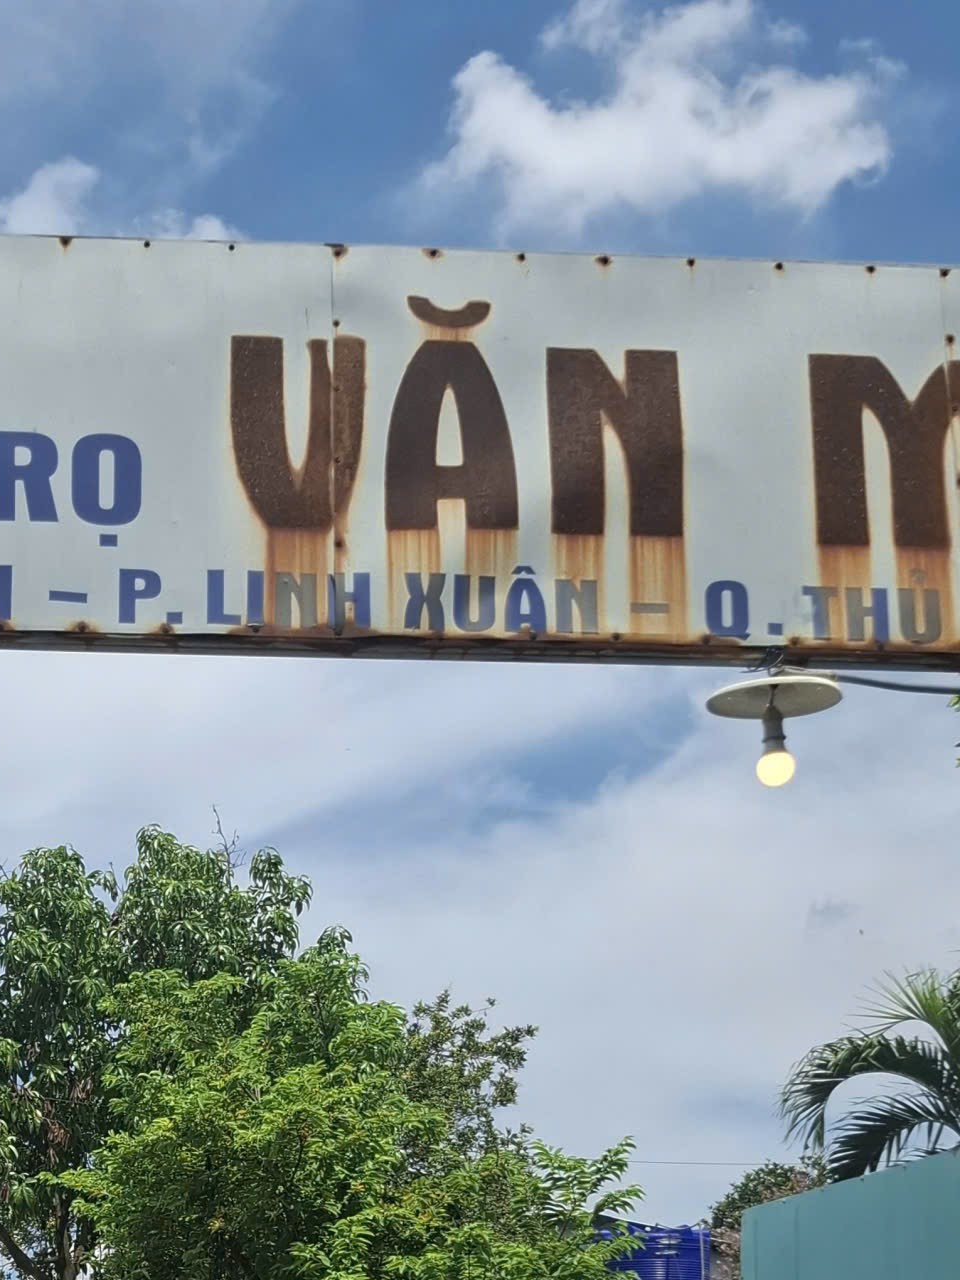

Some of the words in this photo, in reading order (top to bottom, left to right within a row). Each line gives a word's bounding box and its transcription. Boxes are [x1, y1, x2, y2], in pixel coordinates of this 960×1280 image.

[230, 295, 684, 538] VĂN
[207, 569, 370, 632] LINH
[404, 565, 598, 633] XUÂN
[802, 568, 942, 644] THỦ
